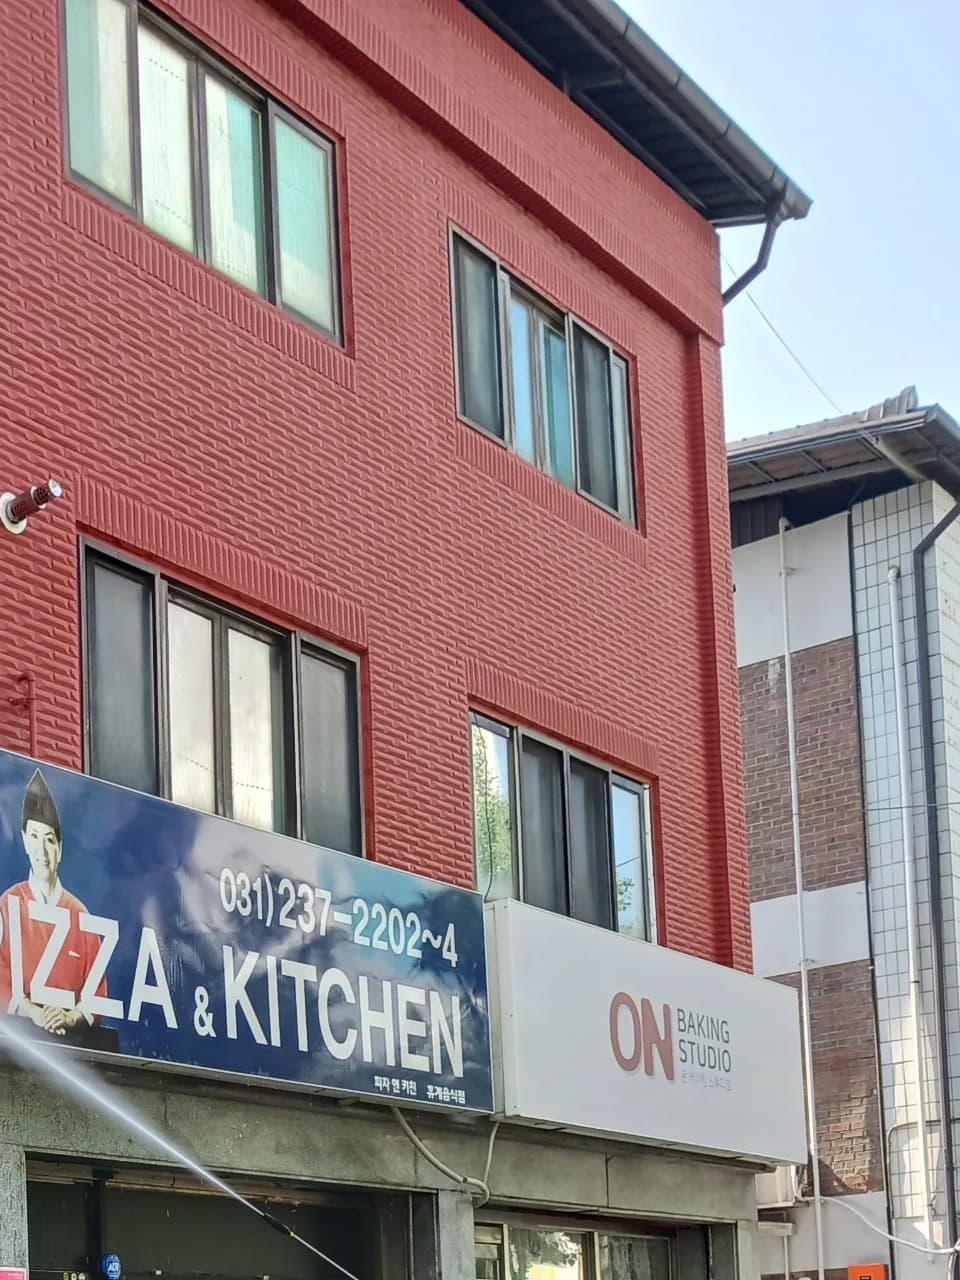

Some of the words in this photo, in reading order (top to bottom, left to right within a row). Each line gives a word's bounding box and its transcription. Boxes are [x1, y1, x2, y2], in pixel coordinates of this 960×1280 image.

[193, 985, 217, 1038] &
[222, 945, 464, 1078] KITCHEN
[677, 1008, 730, 1044] BAKING
[609, 991, 675, 1081] ON
[679, 1039, 732, 1073] STUDIO
[374, 1075, 390, 1092] 피자
[401, 1079, 417, 1096] 키친
